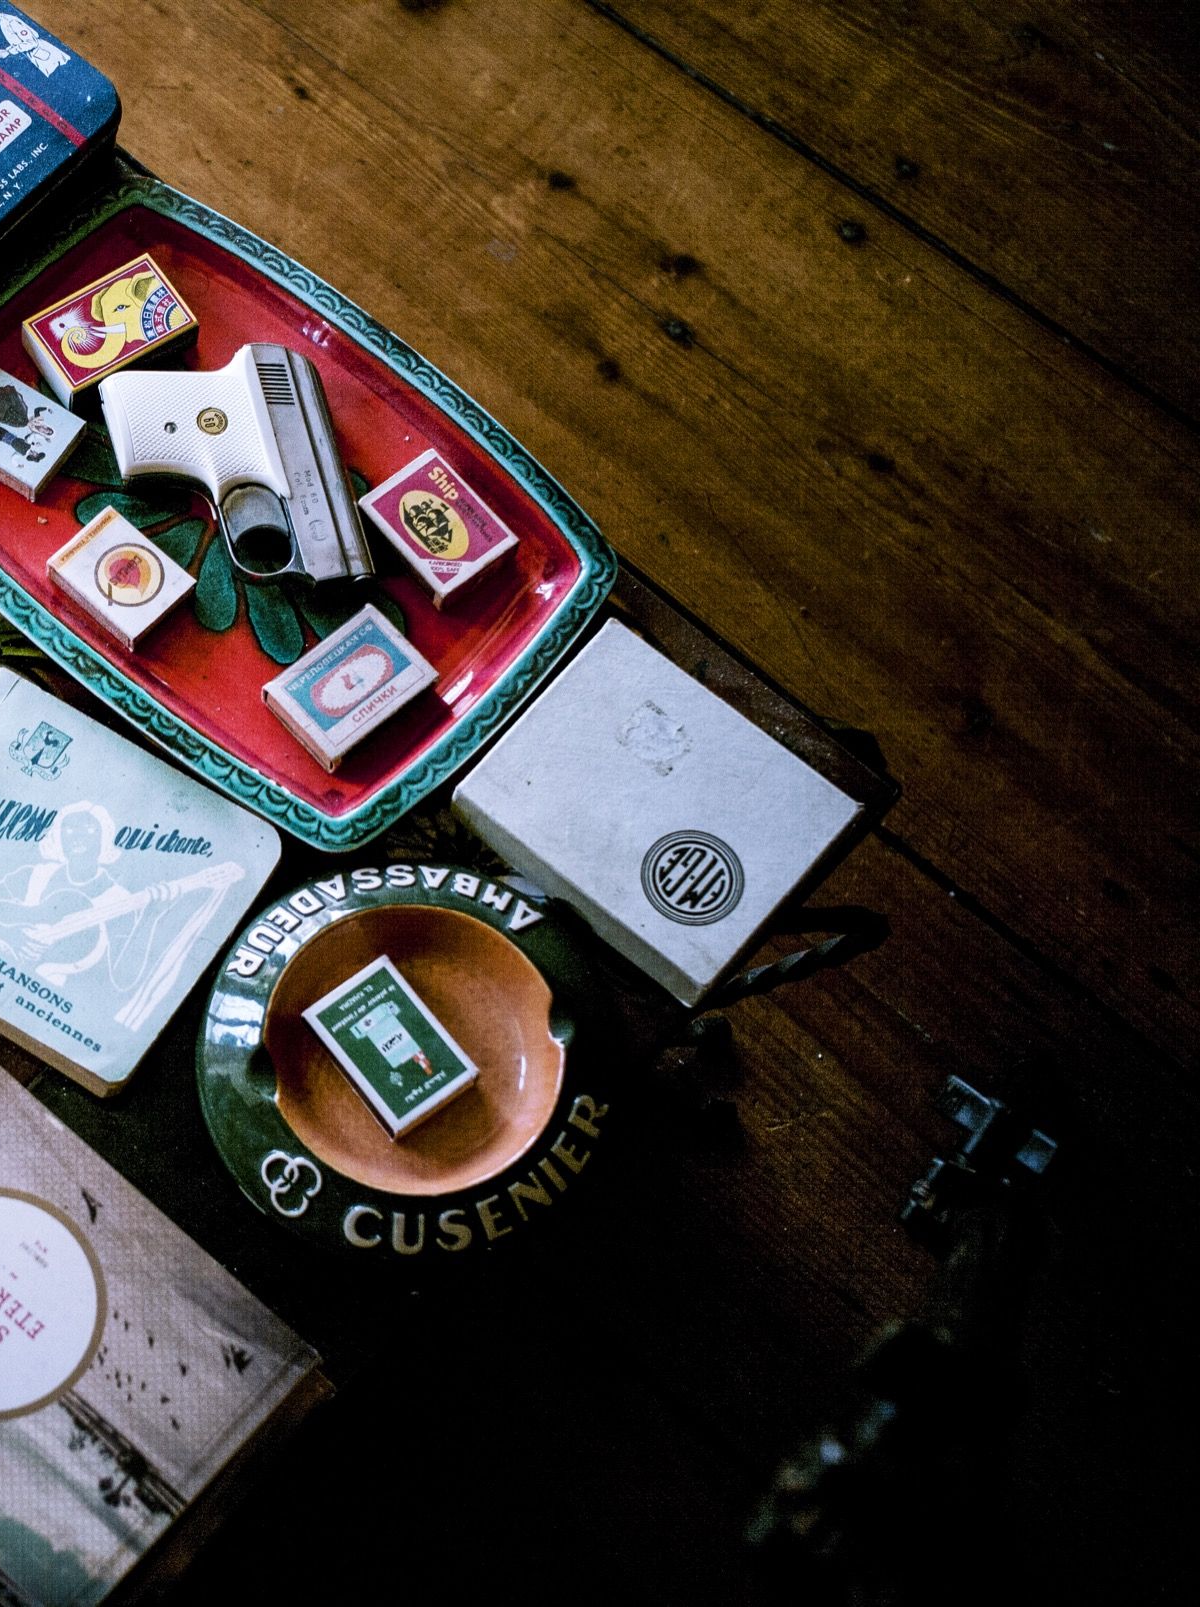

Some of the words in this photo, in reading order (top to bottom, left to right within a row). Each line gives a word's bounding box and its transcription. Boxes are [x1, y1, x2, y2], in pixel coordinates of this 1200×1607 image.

[203, 416, 215, 428] 60
[428, 466, 459, 500] Ship
[351, 684, 398, 724] СПИЧКИ
[226, 863, 543, 980] AMBASSADEUR
[15, 994, 102, 1053] anciennes
[343, 1094, 609, 1254] CUSENIER
